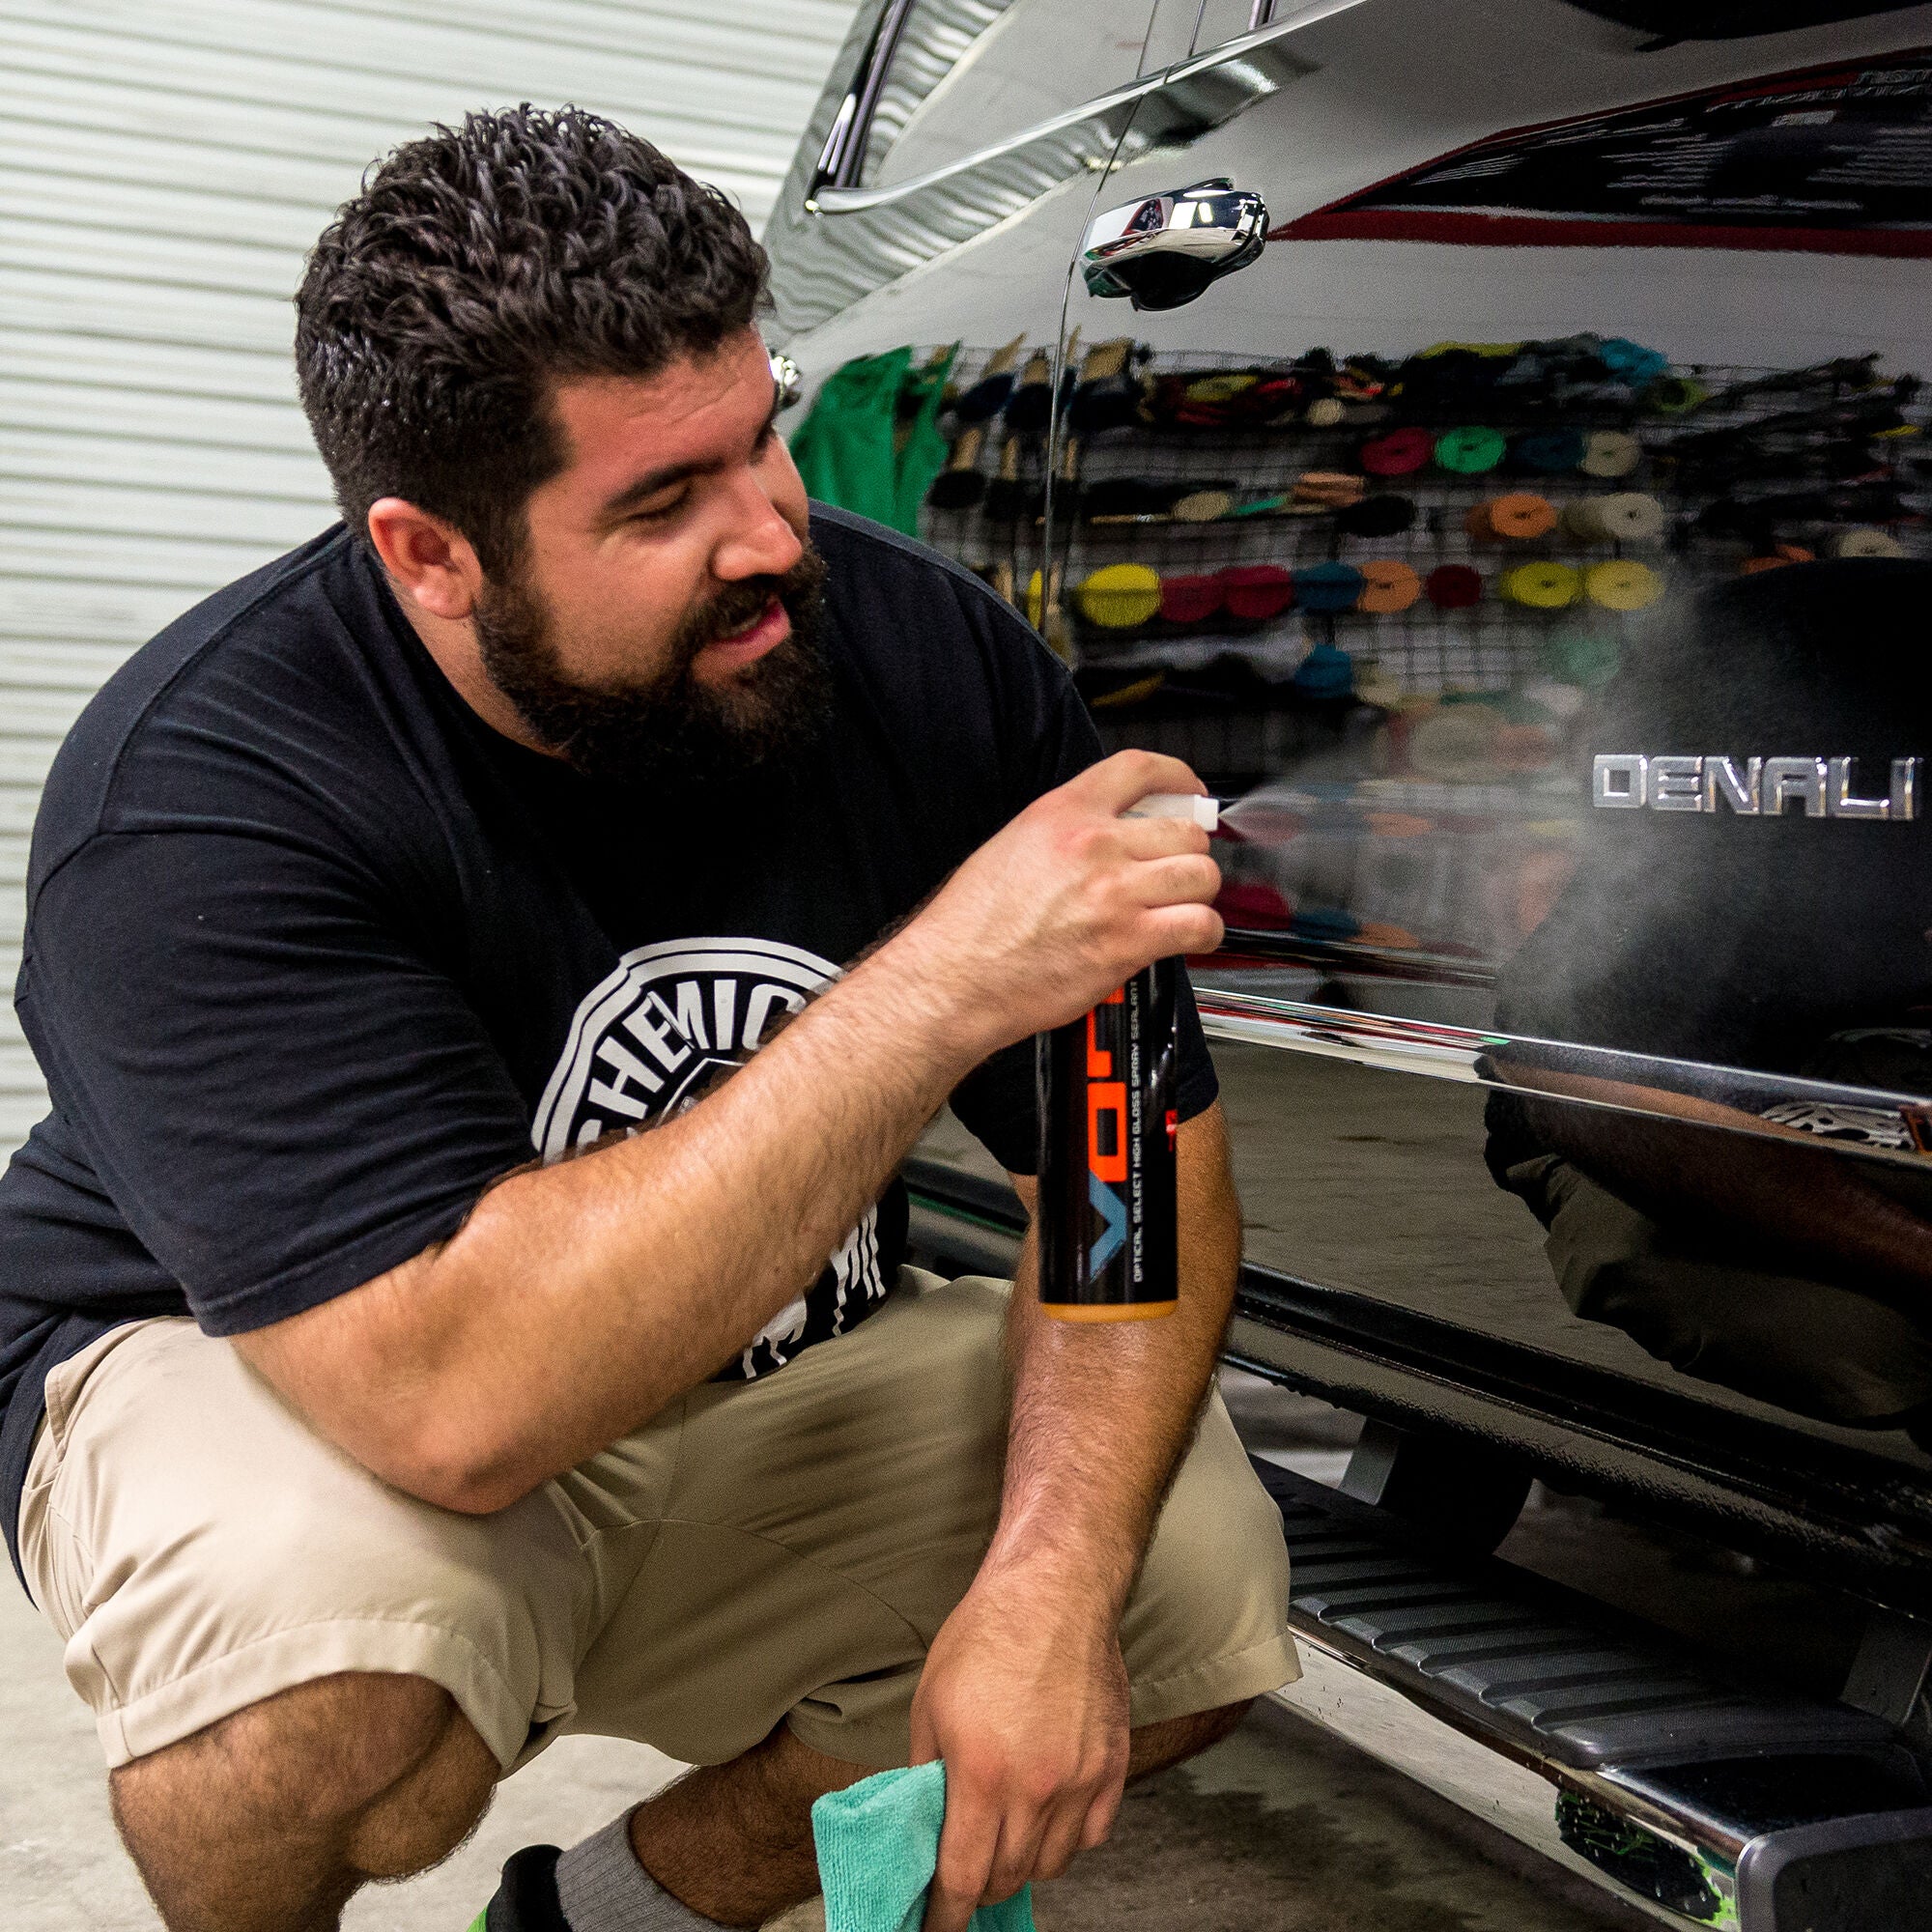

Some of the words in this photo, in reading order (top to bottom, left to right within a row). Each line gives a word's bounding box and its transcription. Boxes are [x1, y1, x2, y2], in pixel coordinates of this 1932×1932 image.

[1594, 753, 1915, 820] DENALI
[1130, 1041, 1141, 1088] SPRAY
[1131, 1089, 1142, 1135] GLOSS
[1131, 1137, 1142, 1169] HIGH
[1132, 1171, 1143, 1224] SELECT
